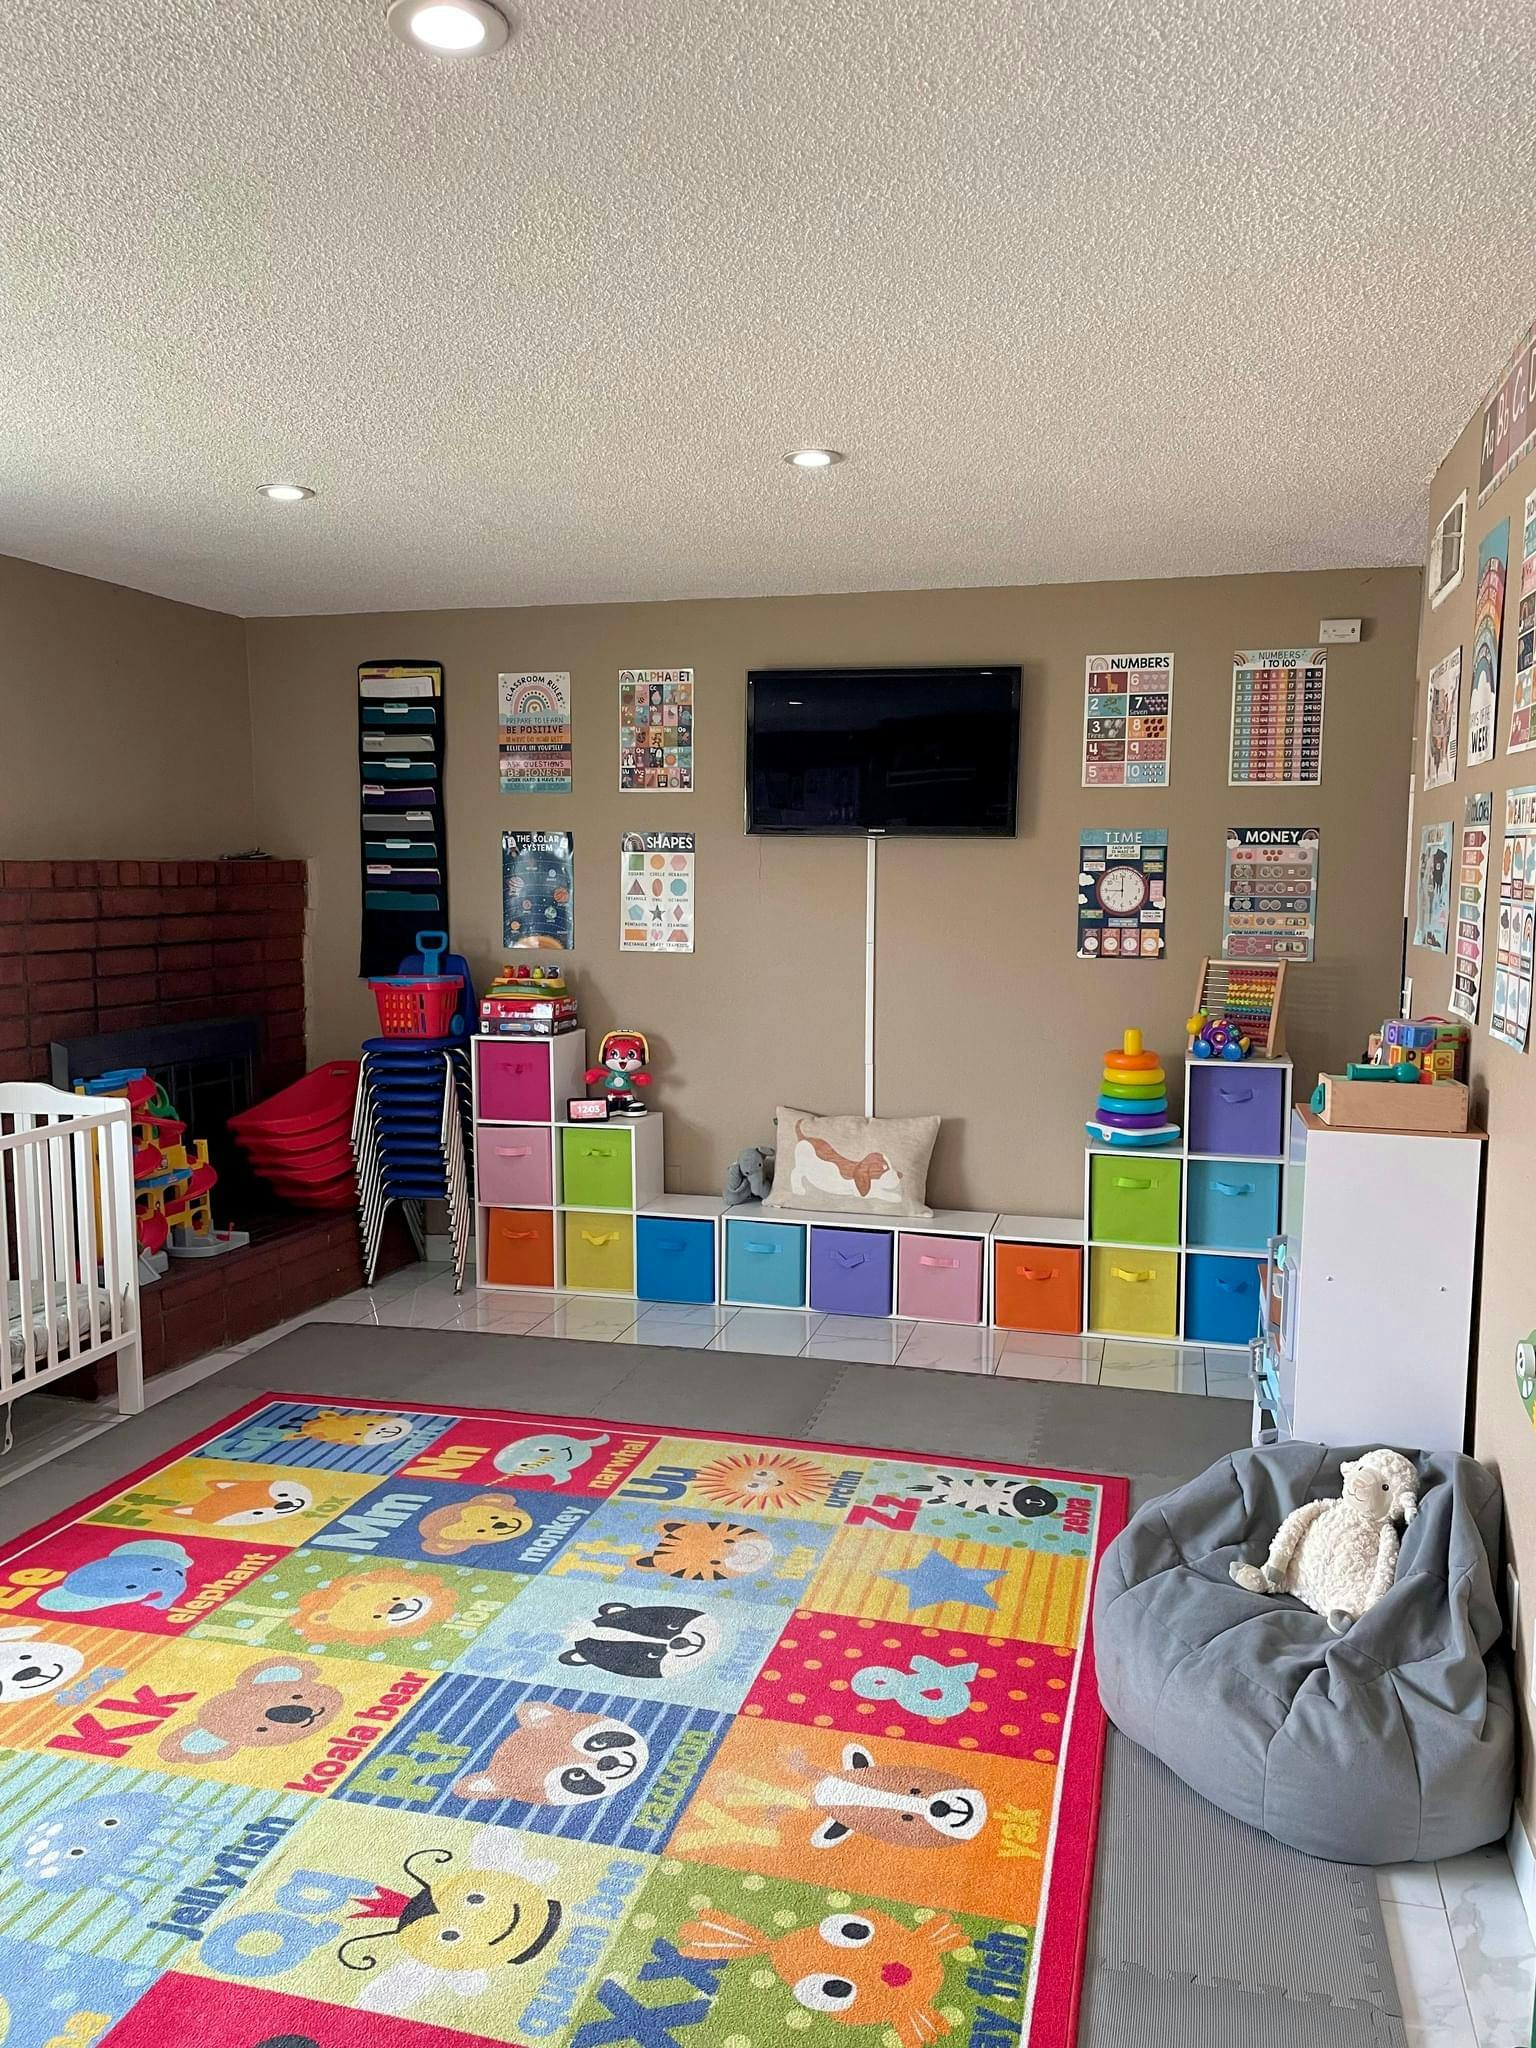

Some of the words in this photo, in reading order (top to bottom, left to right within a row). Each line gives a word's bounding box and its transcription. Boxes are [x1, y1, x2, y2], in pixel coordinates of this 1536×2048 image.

[1496, 388, 1509, 446] Bb
[1513, 366, 1526, 422] Cc
[1110, 656, 1170, 670] NUMBERS
[1258, 650, 1301, 660] NUMBERS
[1282, 659, 1296, 667] 100
[506, 675, 545, 702] CLASSROOM
[547, 680, 564, 702] RULES
[637, 671, 690, 682] ALPHABET
[1093, 674, 1098, 686] 1
[1131, 674, 1140, 686] 6
[1090, 698, 1099, 710] 2
[1134, 697, 1143, 708] 7
[520, 725, 563, 734] POSITIVE
[1092, 721, 1100, 733] 3
[1133, 719, 1141, 730] 8
[1472, 726, 1488, 753] WEEK
[1089, 743, 1098, 755] 4
[1130, 742, 1139, 754] 9
[524, 769, 565, 777] HONEST
[1089, 766, 1097, 777] 5
[1127, 765, 1140, 777] 10
[1508, 798, 1536, 824] WEATHE
[516, 835, 530, 843] THE
[532, 835, 559, 843] SOLAR
[522, 844, 553, 852] SYSTEM
[646, 836, 693, 849] SHAPES
[1105, 832, 1143, 843] TIME
[1246, 831, 1299, 843] MONEY
[403, 1444, 491, 1481] Nn
[588, 1439, 651, 1490] narwhal
[618, 1465, 700, 1501] Uu
[824, 1470, 864, 1510] urchin
[84, 1493, 183, 1526] Ff
[302, 1494, 350, 1520] fox
[311, 1492, 433, 1550] Mm
[844, 1494, 924, 1532] Zz
[1062, 1497, 1092, 1535] zebra
[518, 1505, 592, 1564] monkey
[549, 1540, 644, 1577] Tt
[0, 1568, 68, 1610] Ee
[166, 1552, 278, 1626] elephant
[442, 1600, 504, 1633] lion
[464, 1630, 565, 1678] Ss
[851, 1655, 979, 1717] &
[44, 1684, 200, 1759] Kk
[284, 1715, 384, 1795] koala
[354, 1670, 430, 1723] bear
[346, 1730, 472, 1802] Rr
[632, 1728, 718, 1832] raccoon
[673, 1774, 812, 1852] Yy
[996, 1803, 1045, 1861] yak
[146, 1815, 298, 1942] jellyfish
[200, 1868, 379, 1978] Qq
[516, 1924, 610, 2036] queen
[572, 1860, 648, 1920] bee
[966, 1932, 1028, 1998] fish
[566, 1937, 730, 2048] Xx
